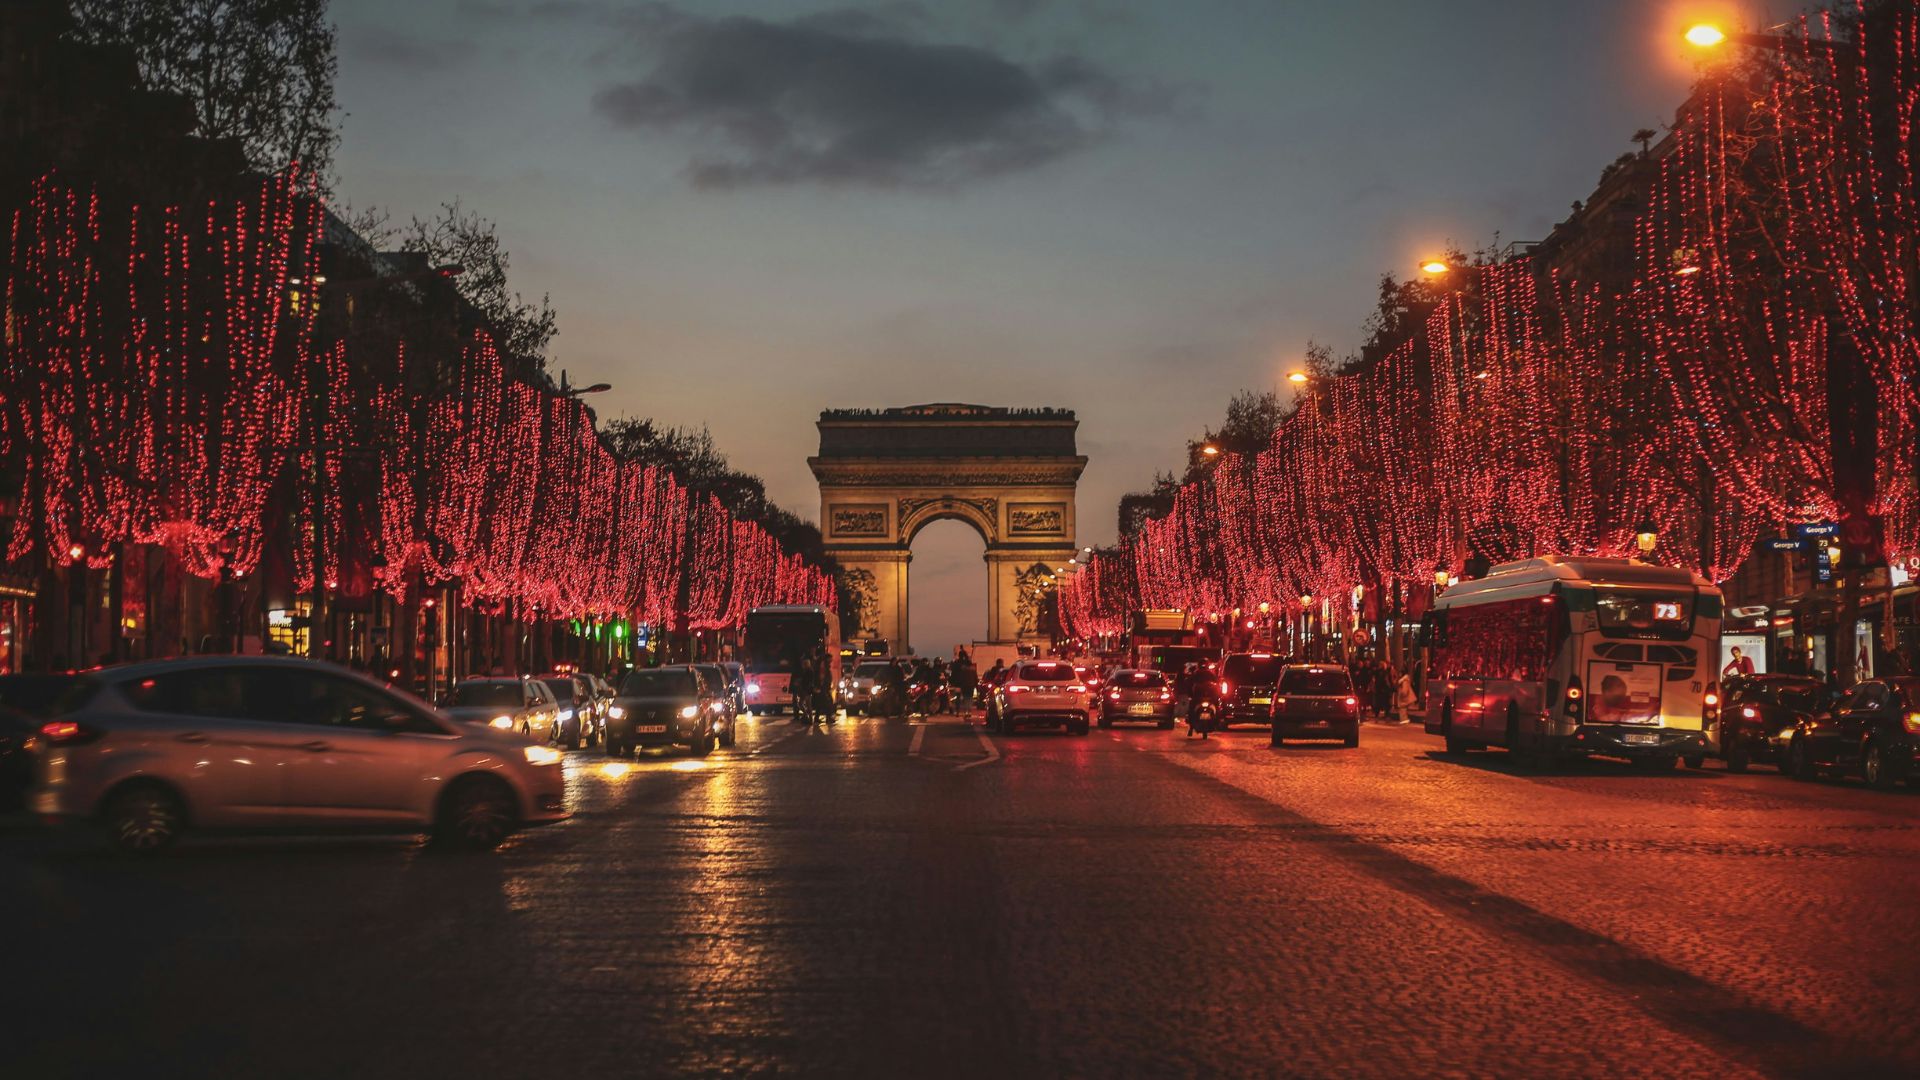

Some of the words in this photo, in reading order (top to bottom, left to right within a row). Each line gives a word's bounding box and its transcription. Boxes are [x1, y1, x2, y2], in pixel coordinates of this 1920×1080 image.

[1806, 526, 1827, 534] George
[1773, 542, 1794, 550] George
[1657, 604, 1677, 618] 73
